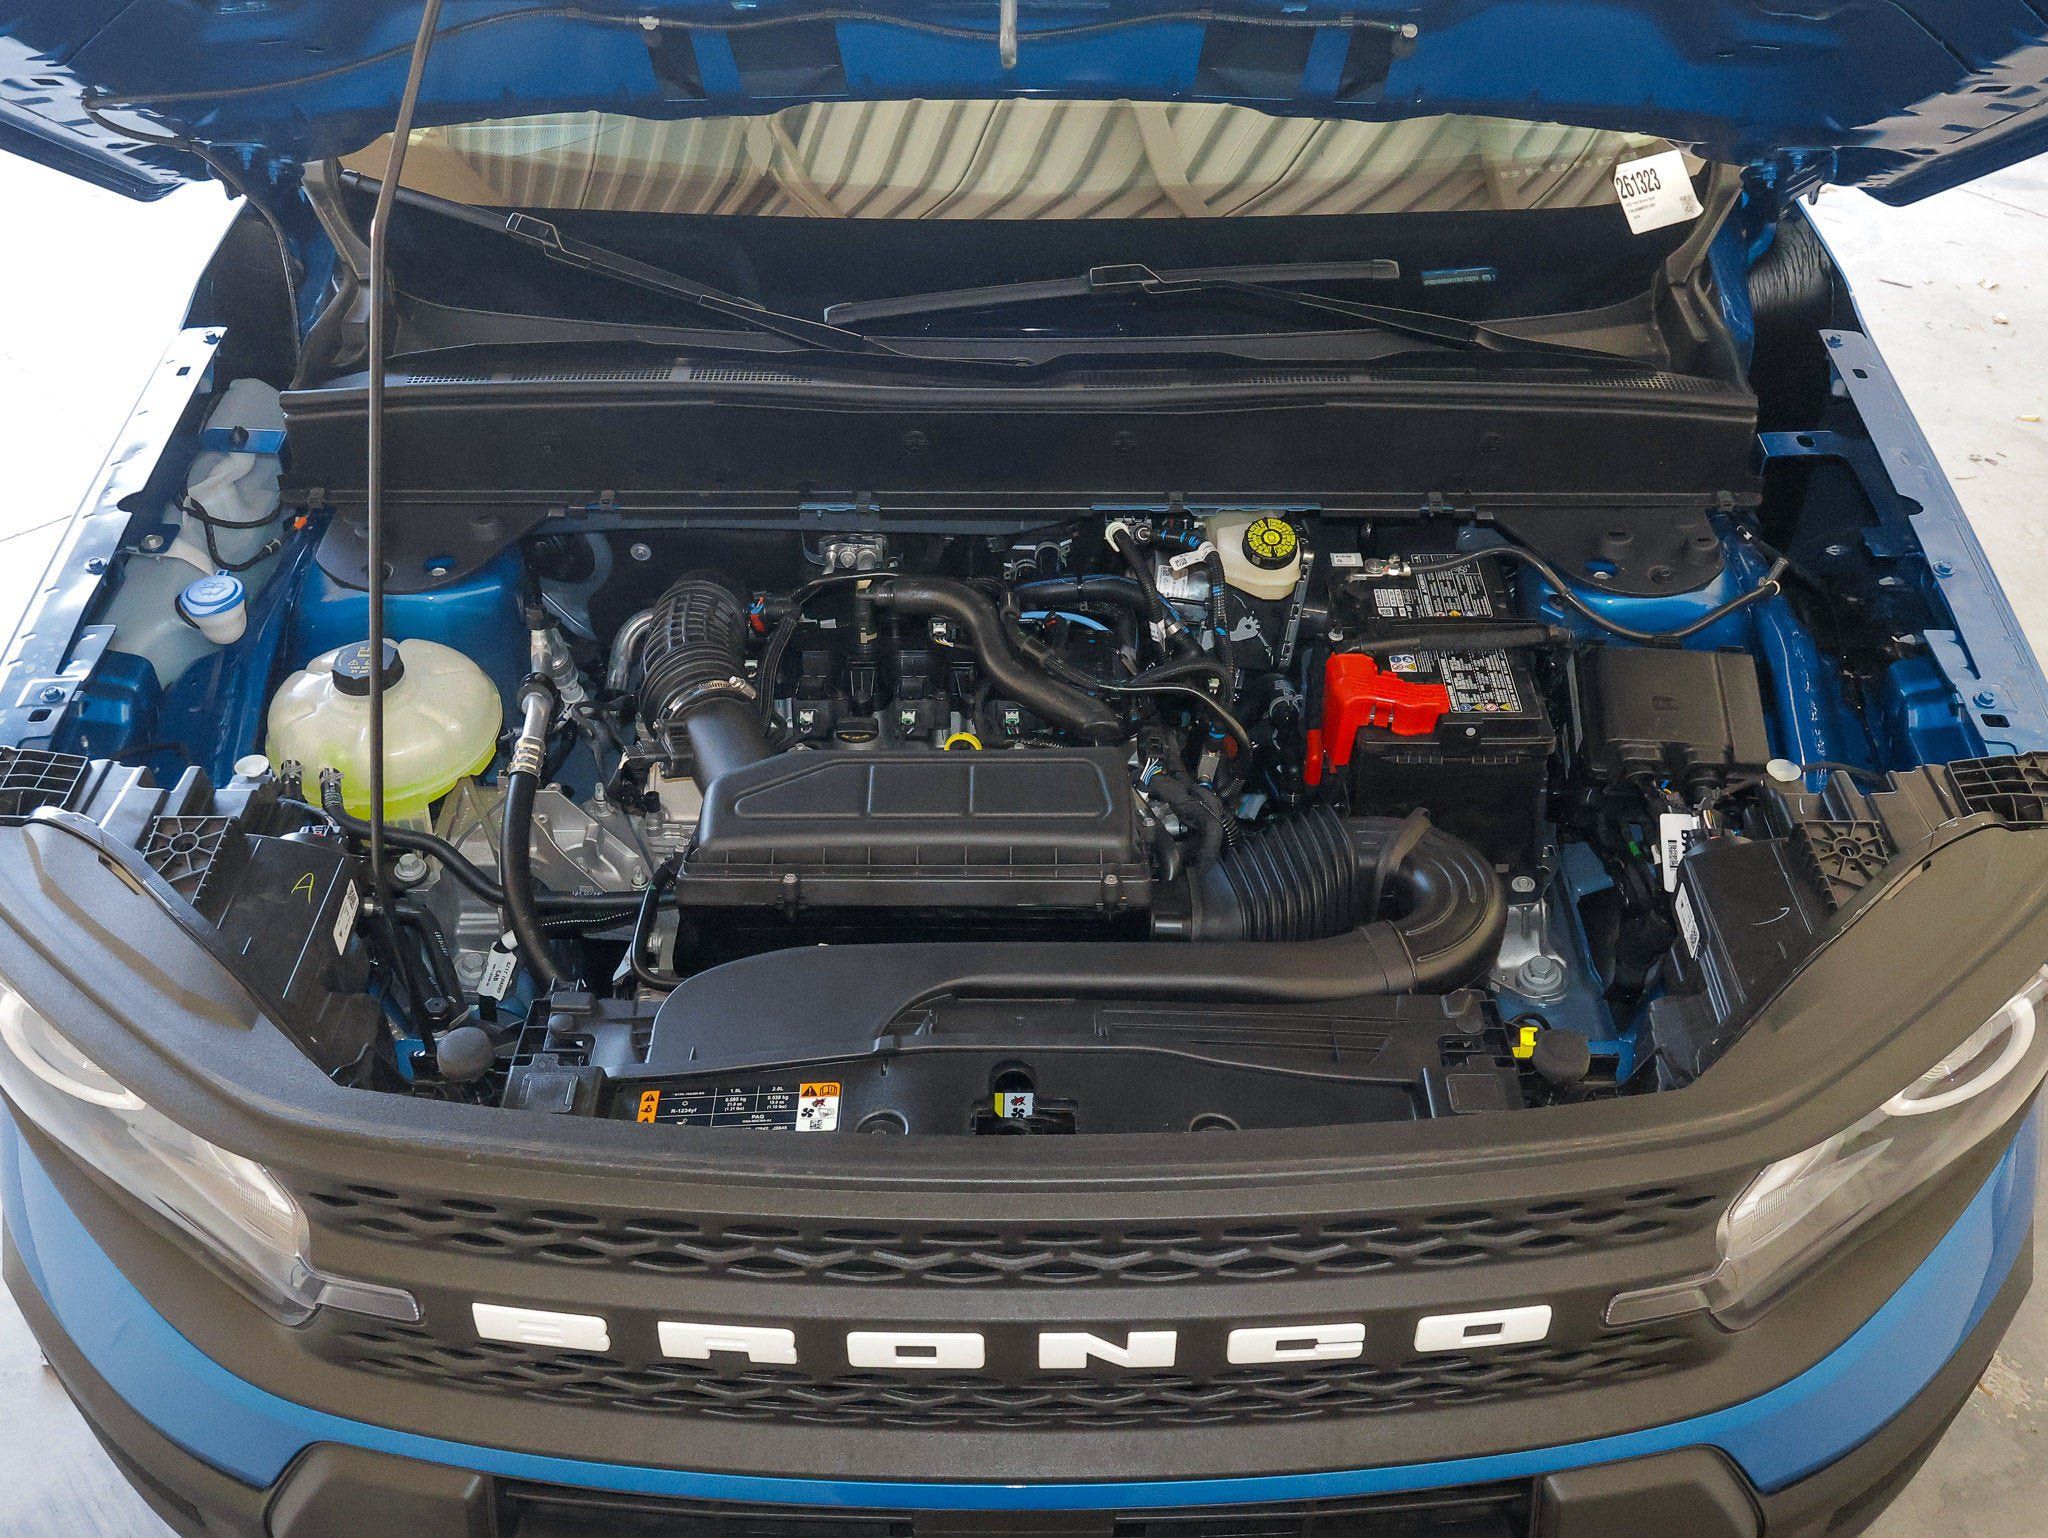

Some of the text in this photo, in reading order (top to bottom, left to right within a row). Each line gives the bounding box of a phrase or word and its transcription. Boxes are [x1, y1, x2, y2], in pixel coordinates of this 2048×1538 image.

[1615, 167, 1662, 199] 261323
[291, 872, 316, 904] A
[471, 1302, 1552, 1369] BRONCO
